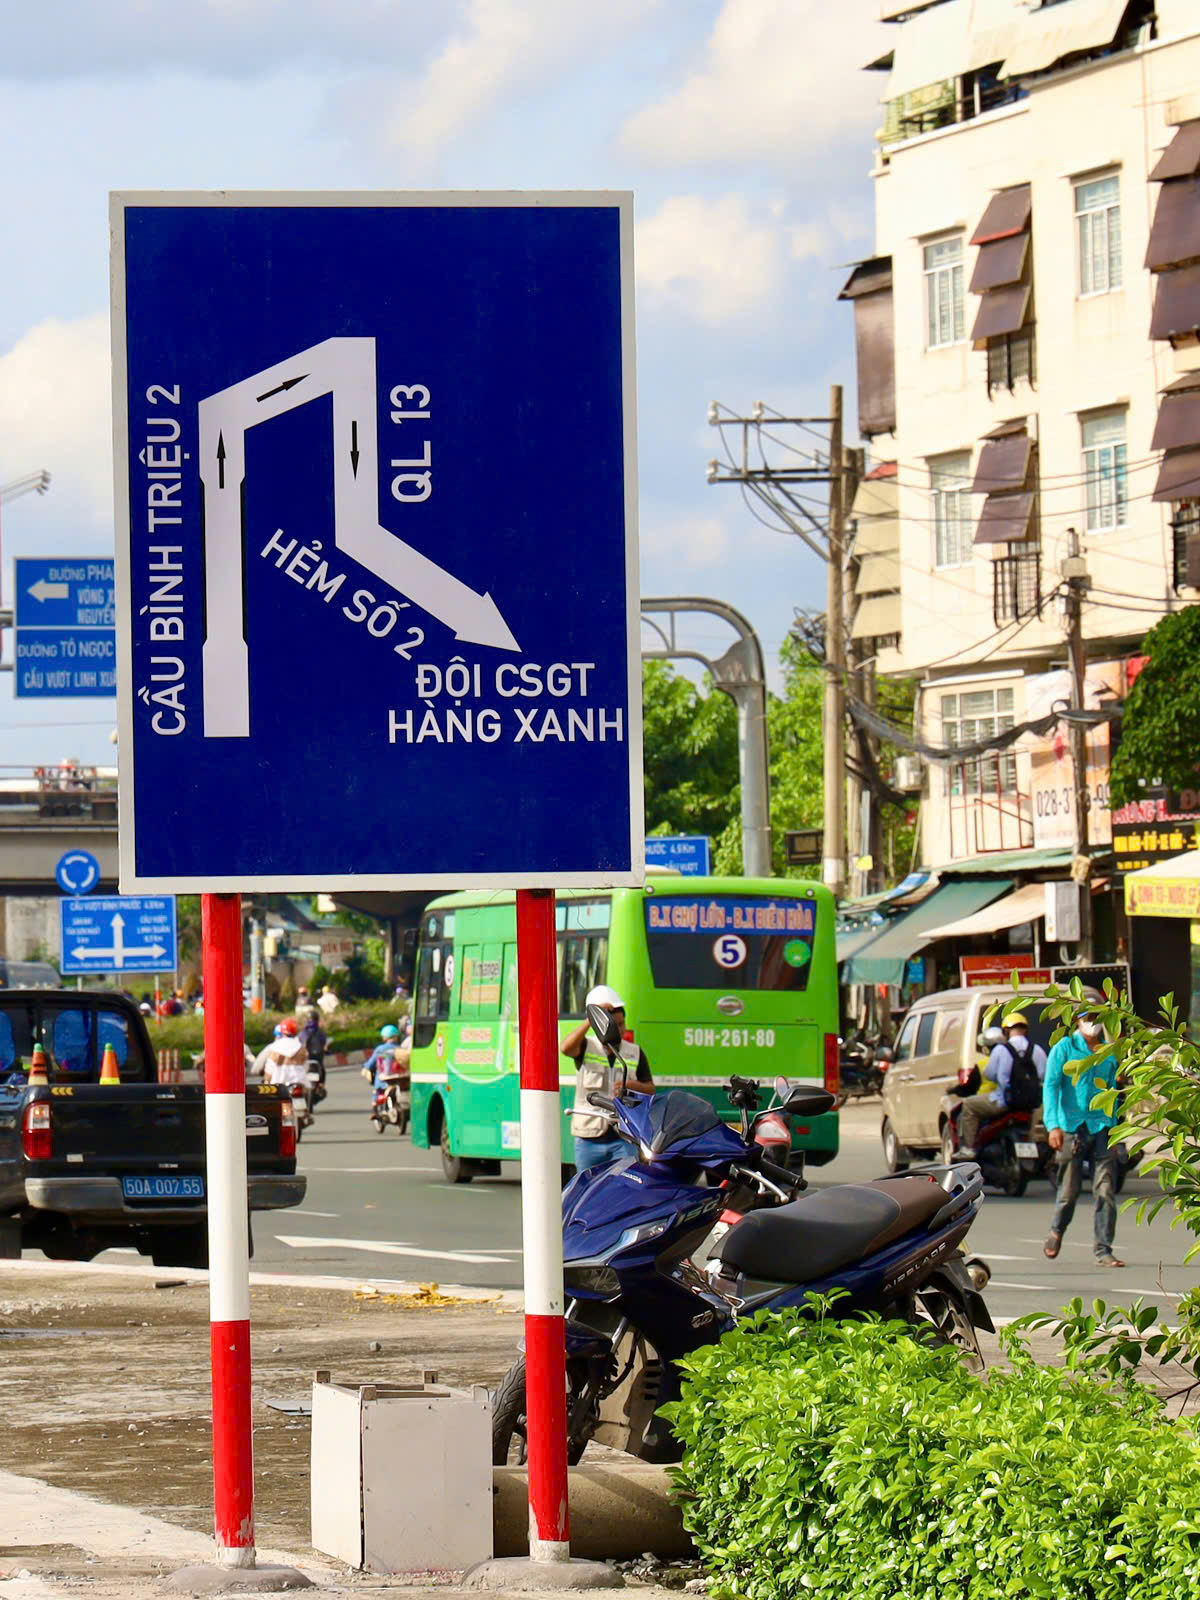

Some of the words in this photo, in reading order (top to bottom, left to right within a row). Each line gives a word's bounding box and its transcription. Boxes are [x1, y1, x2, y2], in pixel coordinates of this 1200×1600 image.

[146, 384, 181, 405] 2
[390, 383, 432, 424] 13
[138, 418, 191, 533] TRIỆU
[390, 440, 433, 503] QL
[140, 546, 185, 641] BÌNH
[260, 528, 347, 603] HẺM
[342, 589, 411, 638] SỐ
[393, 626, 425, 660] 2
[74, 670, 97, 688] LINH
[138, 656, 186, 736] CẦU
[415, 655, 481, 706] ĐỘI
[495, 662, 596, 698] CSGT
[388, 700, 502, 744] HÀNG
[513, 707, 624, 742] XANH
[672, 903, 698, 932] CHỢ
[701, 901, 726, 929] LỚN
[756, 902, 785, 930] BIÊN
[787, 902, 813, 931] HÒA
[721, 939, 740, 966] 5
[684, 1028, 776, 1048] 50H-261-80
